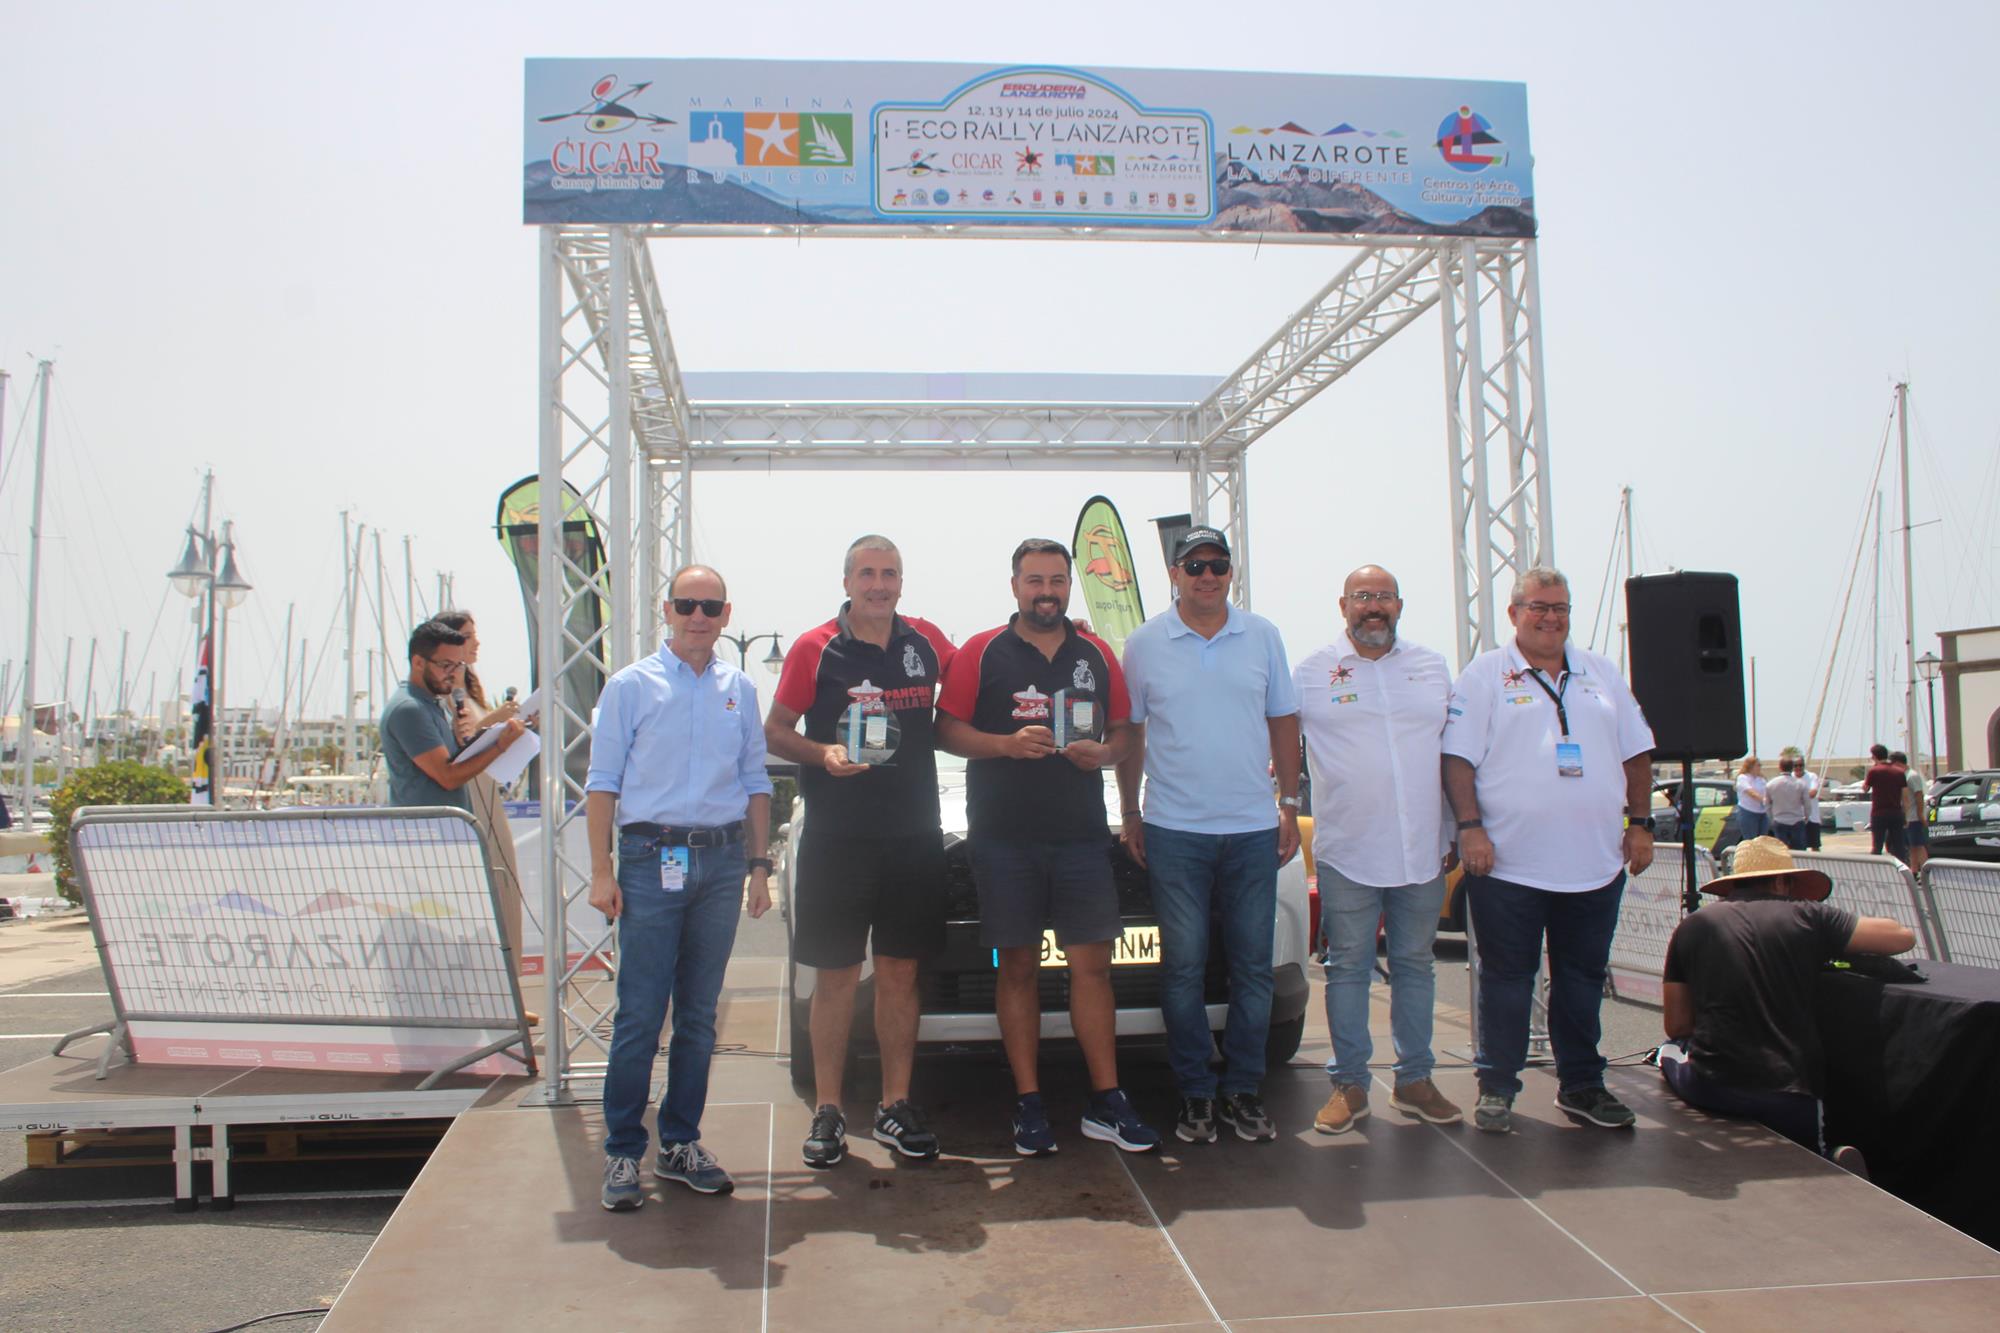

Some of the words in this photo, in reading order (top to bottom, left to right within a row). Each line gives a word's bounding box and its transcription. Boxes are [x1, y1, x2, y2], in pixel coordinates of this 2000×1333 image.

[1000, 90, 1085, 99] LANZAROTE
[1002, 84, 1086, 93] ESCUDERIA
[689, 97, 853, 108] MARINA
[968, 106, 985, 117] 12,
[989, 106, 1003, 117] 13
[1007, 107, 1014, 118] y
[1018, 107, 1031, 118] 14
[1035, 105, 1053, 117] de
[1056, 106, 1085, 119] julio
[1087, 108, 1119, 120] 2024
[907, 120, 957, 139] ECO
[964, 121, 1044, 141] RALLY
[1051, 123, 1200, 145] LANZAROTE
[551, 141, 663, 174] CICAR
[1228, 143, 1408, 165] LANZAROTE
[952, 153, 1002, 169] CICAR
[1125, 163, 1201, 173] LANZAROTE
[1228, 167, 1251, 181] LA
[1260, 168, 1300, 182] ISLA
[1309, 169, 1412, 184] DIFERENTE
[1423, 177, 1469, 190] Centros
[1477, 193, 1521, 206] Turismo
[884, 686, 932, 699] PANCHO
[885, 697, 919, 711] VILLA
